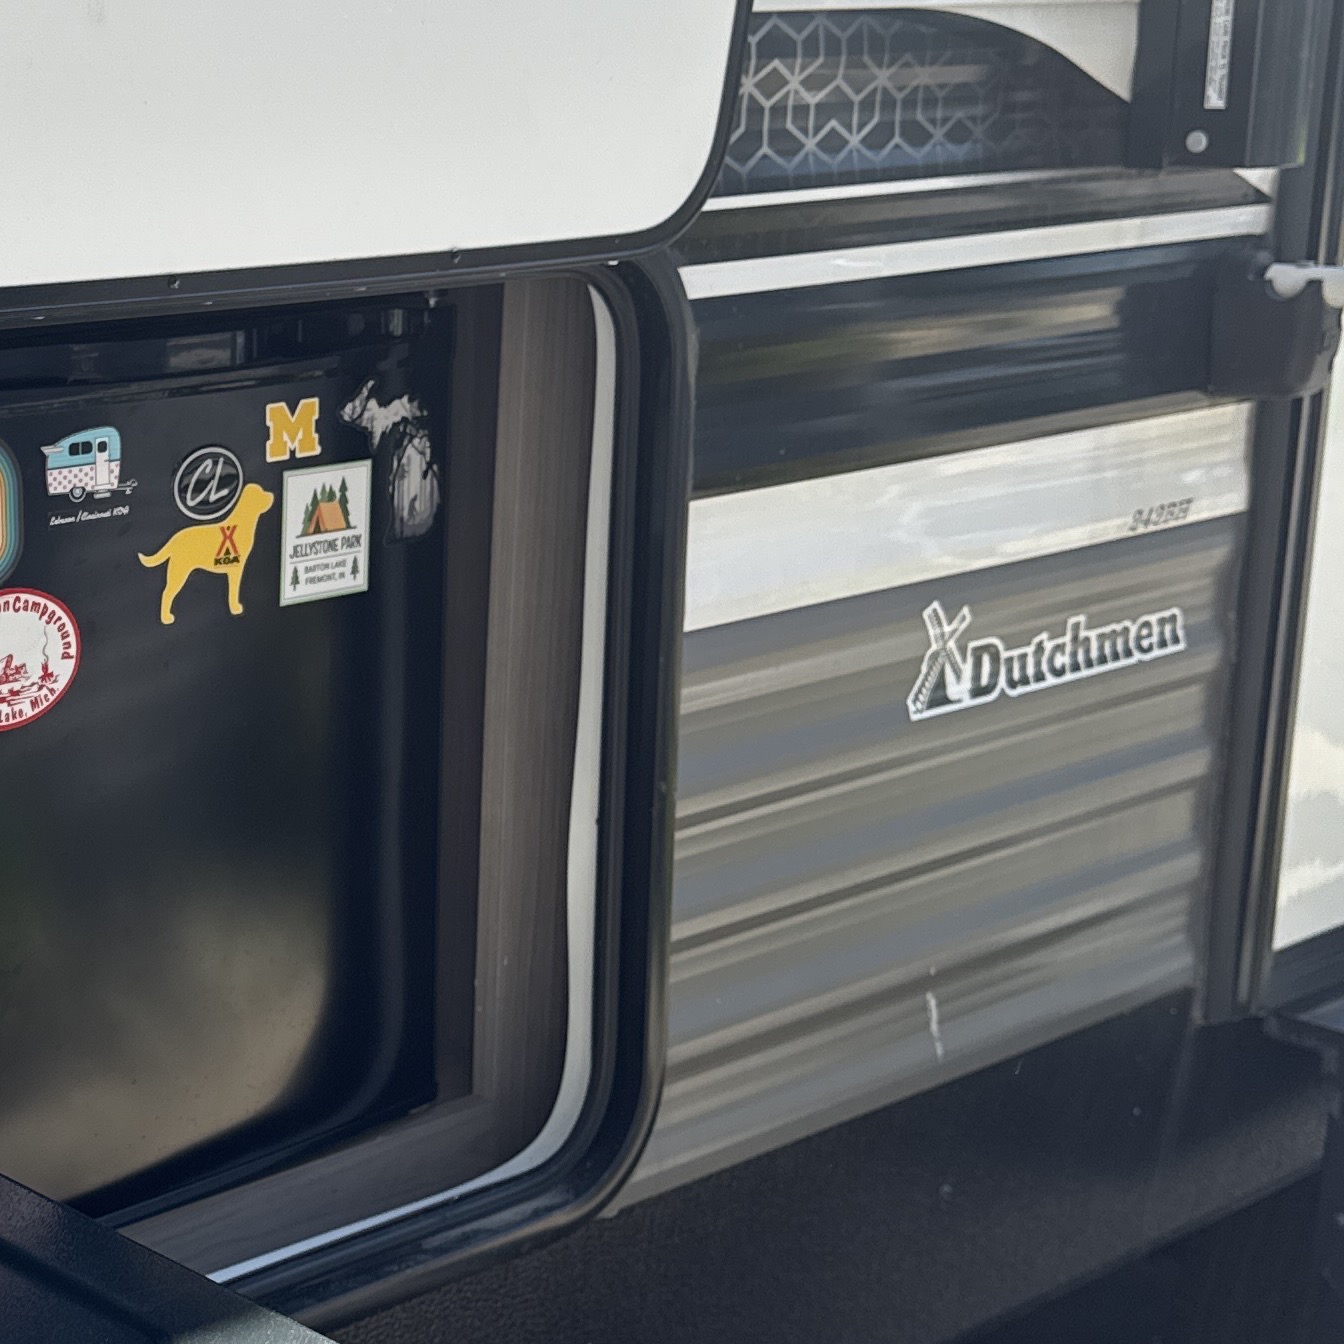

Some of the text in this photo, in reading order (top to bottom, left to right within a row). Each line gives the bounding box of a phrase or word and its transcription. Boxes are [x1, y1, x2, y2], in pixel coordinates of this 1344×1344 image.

[266, 397, 321, 463] M
[186, 457, 229, 506] CL
[214, 555, 241, 566] KOA
[289, 534, 362, 560] JELLYSTONE PARK
[330, 559, 347, 569] LAKE
[12, 595, 75, 660] Campground
[967, 609, 1184, 702] Dutchmen
[29, 687, 60, 712] Mich.
